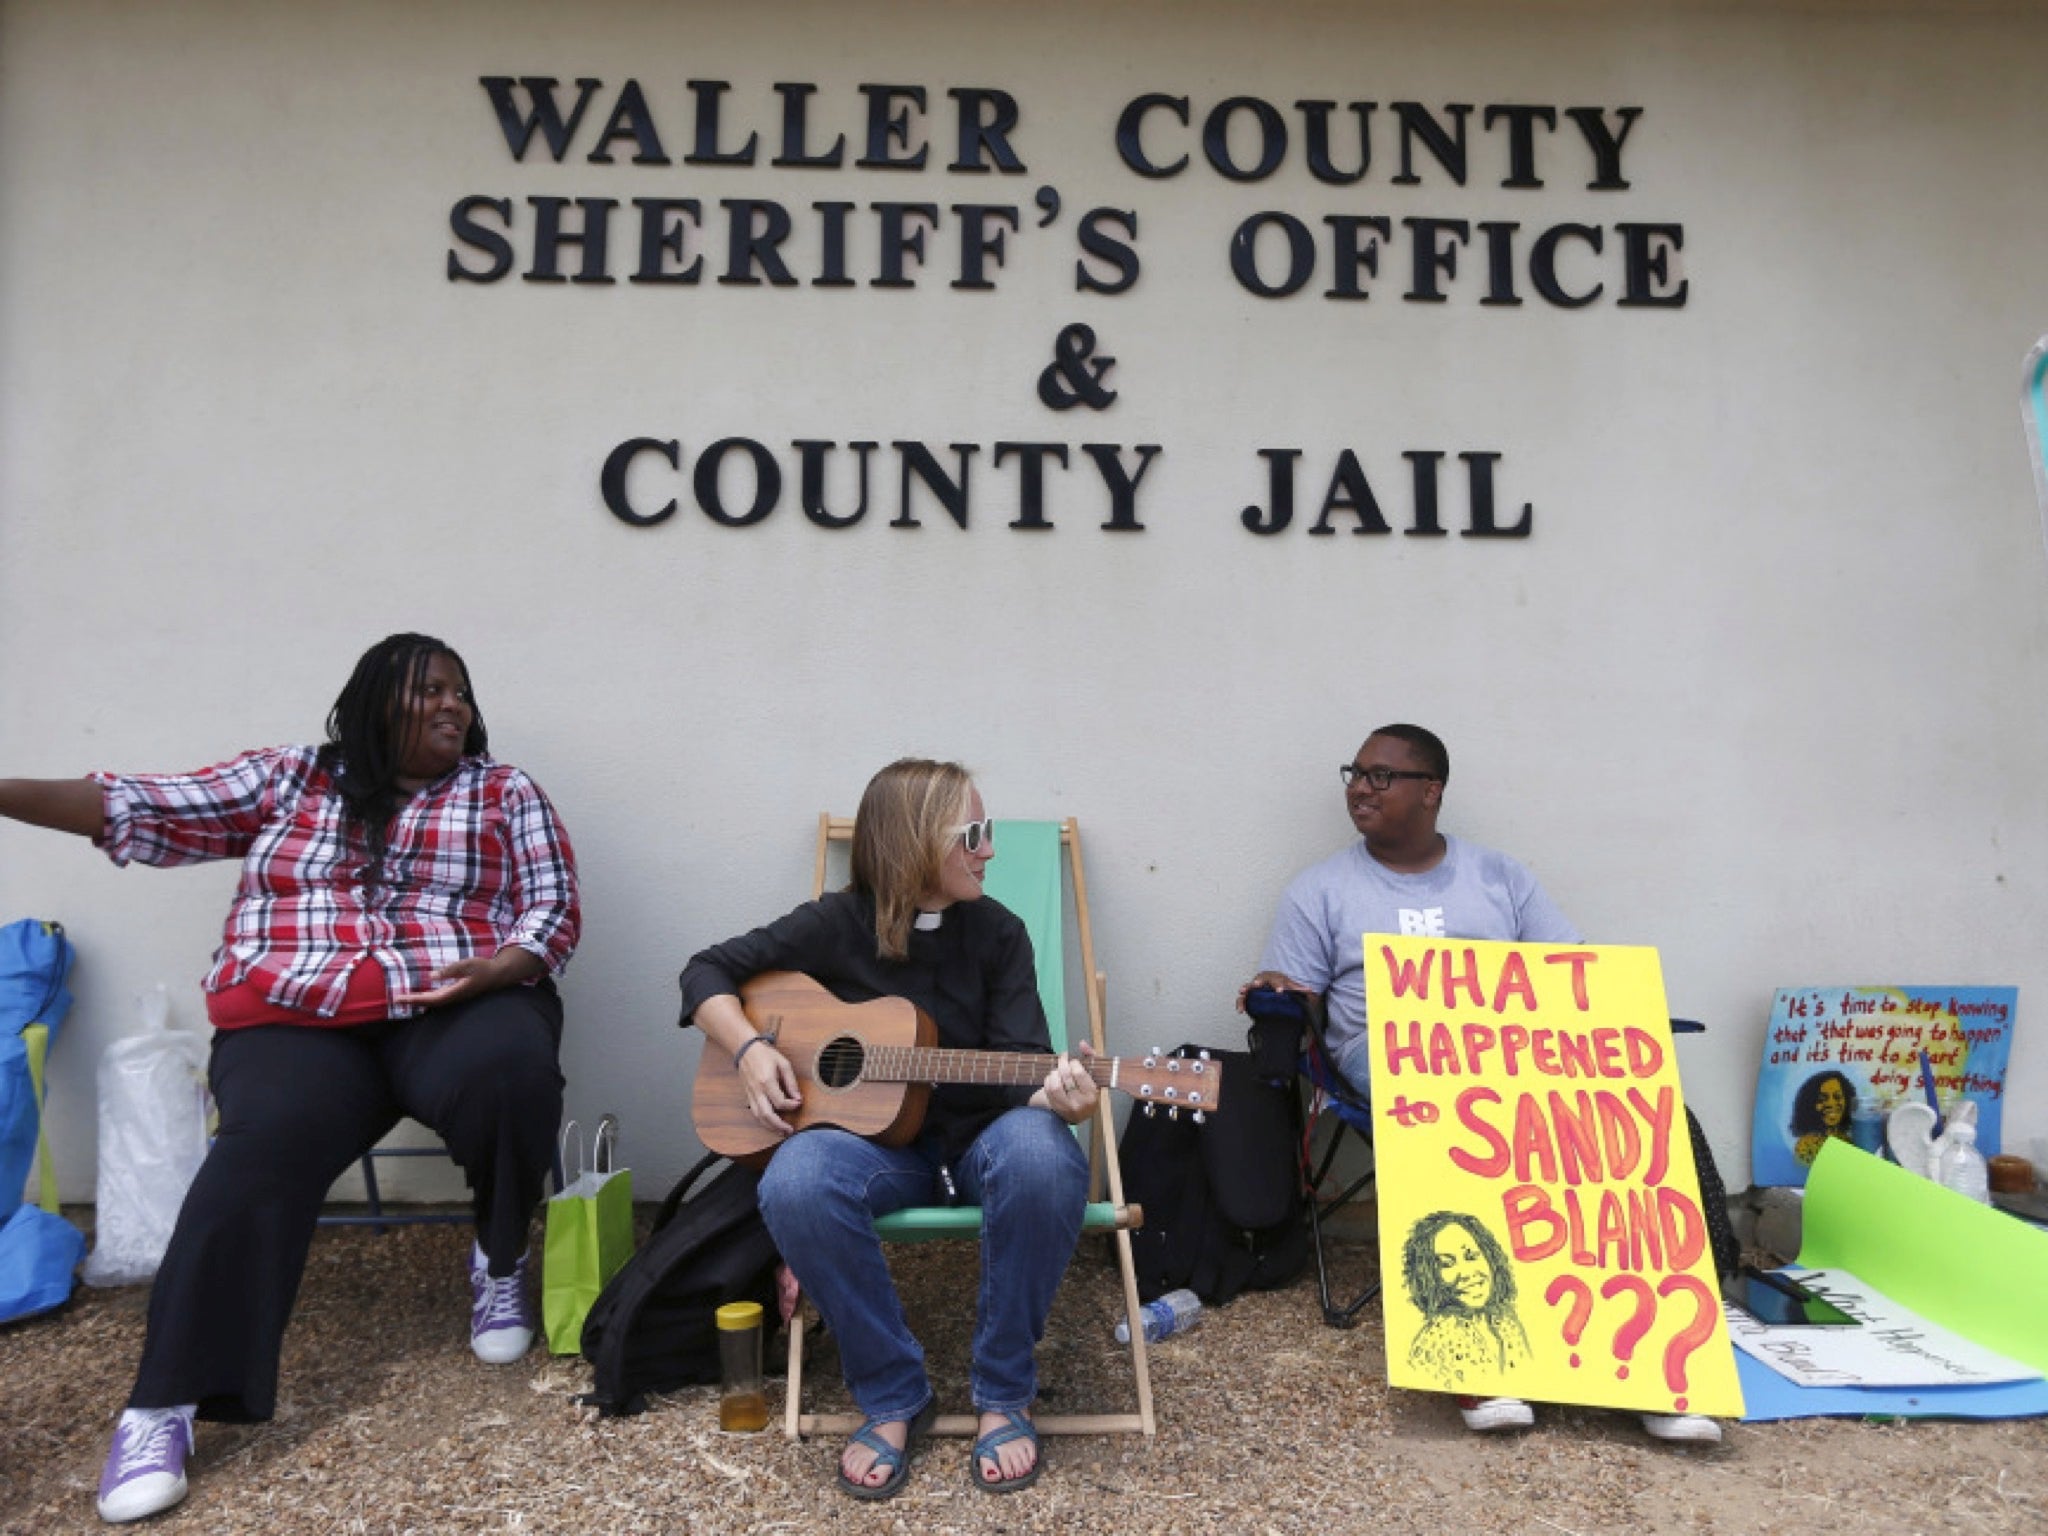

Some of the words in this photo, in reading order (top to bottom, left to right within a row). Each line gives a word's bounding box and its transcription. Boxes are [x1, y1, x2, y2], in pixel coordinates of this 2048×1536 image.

[479, 75, 1027, 174] WALLER
[1115, 92, 1644, 191] COUNTY
[447, 184, 1140, 295] SHERIFF'S
[1230, 210, 1689, 309] OFFICE
[1036, 322, 1118, 412] &
[600, 437, 1163, 532] COUNTY
[1241, 448, 1533, 538] JAIL
[1398, 906, 1446, 937] BE
[1380, 944, 1599, 1014] WHAT
[1840, 991, 1876, 1016] time
[1880, 994, 1898, 1013] to
[1905, 996, 1943, 1020] stop
[1384, 1019, 1664, 1079] HAPPENED
[1770, 1046, 1800, 1065] and
[1806, 1041, 1830, 1062] it's
[1838, 1041, 1874, 1064] time
[1879, 1041, 1900, 1064] to
[1774, 1021, 1808, 1044] that
[1856, 1025, 1883, 1040] was
[1886, 1025, 1923, 1048] going
[1928, 1022, 1948, 1041] to
[1870, 1068, 1911, 1095] doing
[1386, 1095, 1441, 1127] to
[1448, 1085, 1675, 1187] SANDY
[1501, 1183, 1706, 1273] BLAND
[1544, 1273, 1719, 1413] ???
